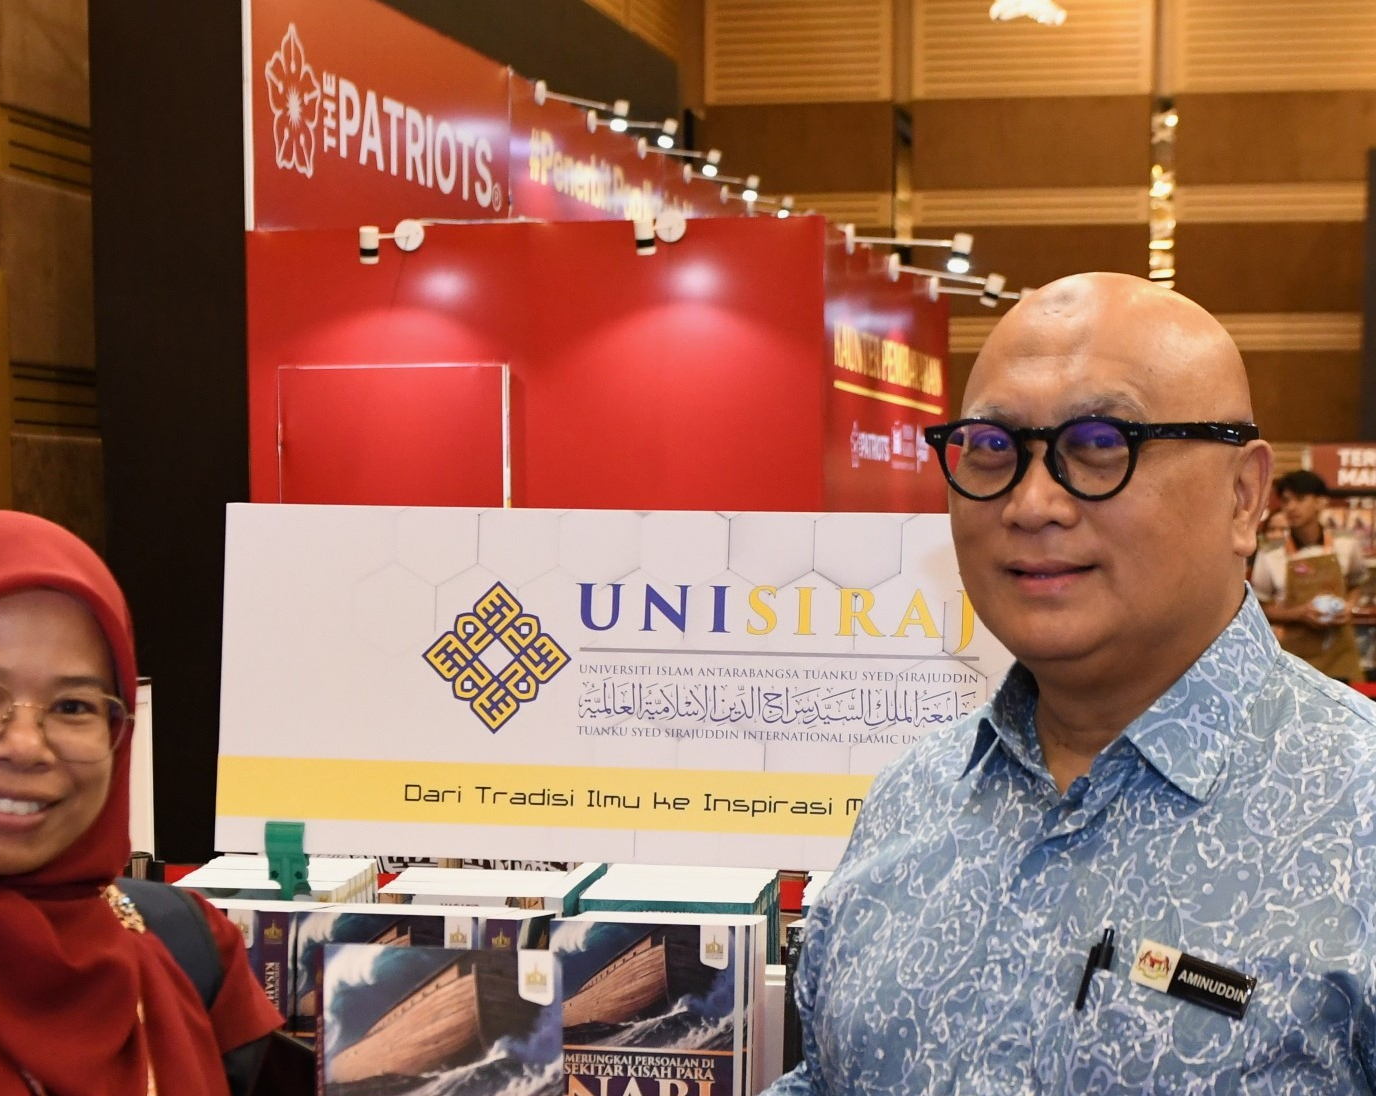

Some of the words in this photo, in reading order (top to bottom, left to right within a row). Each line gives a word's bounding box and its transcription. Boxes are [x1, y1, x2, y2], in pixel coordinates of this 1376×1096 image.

[323, 71, 337, 153] THE
[339, 77, 493, 208] PATRIOTS
[576, 582, 976, 655] UNISIRAJ
[579, 664, 652, 676] UNIVERSITI
[656, 665, 694, 677] ISLAM
[698, 667, 800, 680] ANTARABANGSA
[803, 669, 858, 682] TUANKU
[862, 671, 894, 683] SYED
[896, 672, 980, 684] SIRAJUDDIN
[576, 725, 629, 737] TUANKU
[631, 727, 661, 738] SYED
[664, 728, 739, 741] SIRAJUDDIN
[742, 730, 845, 744] INTERNATIONAL
[848, 733, 898, 746] ISLAMIC
[404, 783, 462, 803] Dari
[475, 786, 575, 807] Tradisi
[587, 789, 640, 809] Ilmu
[653, 791, 690, 811] ke
[704, 793, 832, 817] Inspirasi
[845, 797, 864, 816] M
[1177, 969, 1249, 1005] AMINUDDIN
[563, 1063, 624, 1076] SEKITAR
[627, 1064, 672, 1079] KISAH
[676, 1067, 714, 1080] PARA
[564, 1054, 632, 1065] MERUNGKAI
[635, 1055, 700, 1067] PERSOALAN
[702, 1058, 715, 1068] DI
